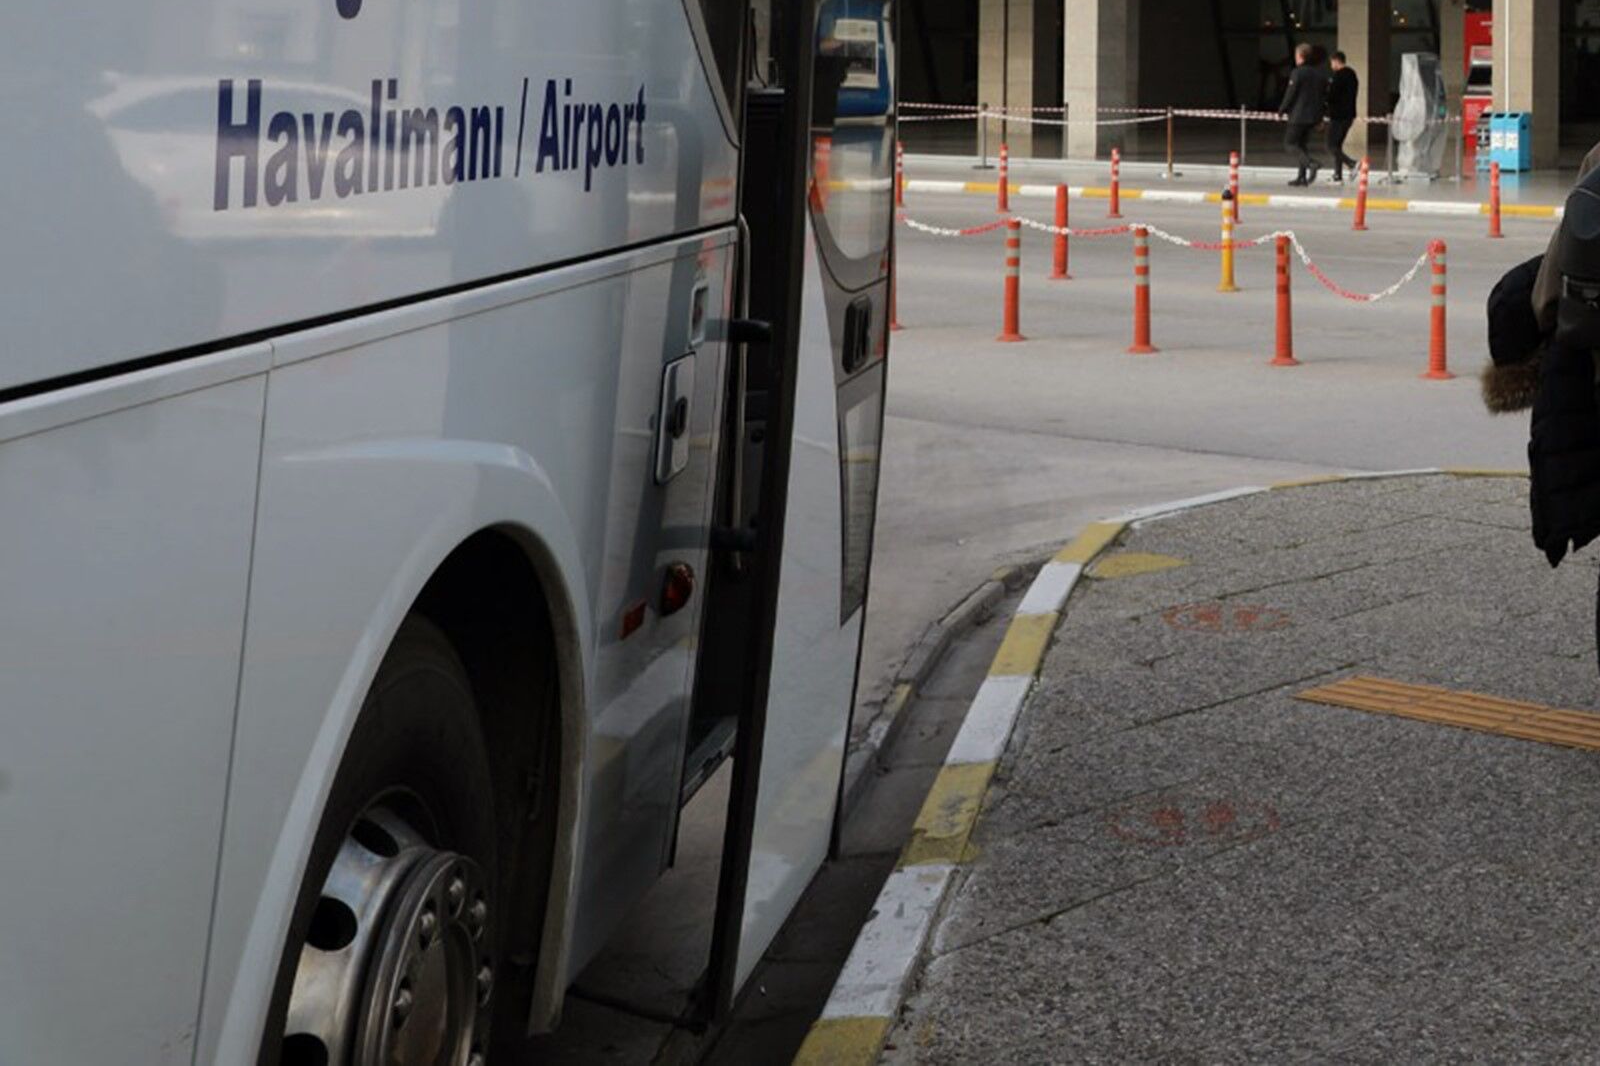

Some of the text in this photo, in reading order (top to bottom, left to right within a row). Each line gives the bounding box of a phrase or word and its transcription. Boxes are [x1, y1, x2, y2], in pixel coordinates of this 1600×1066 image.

[213, 77, 647, 212] Havalimanı / Airport
